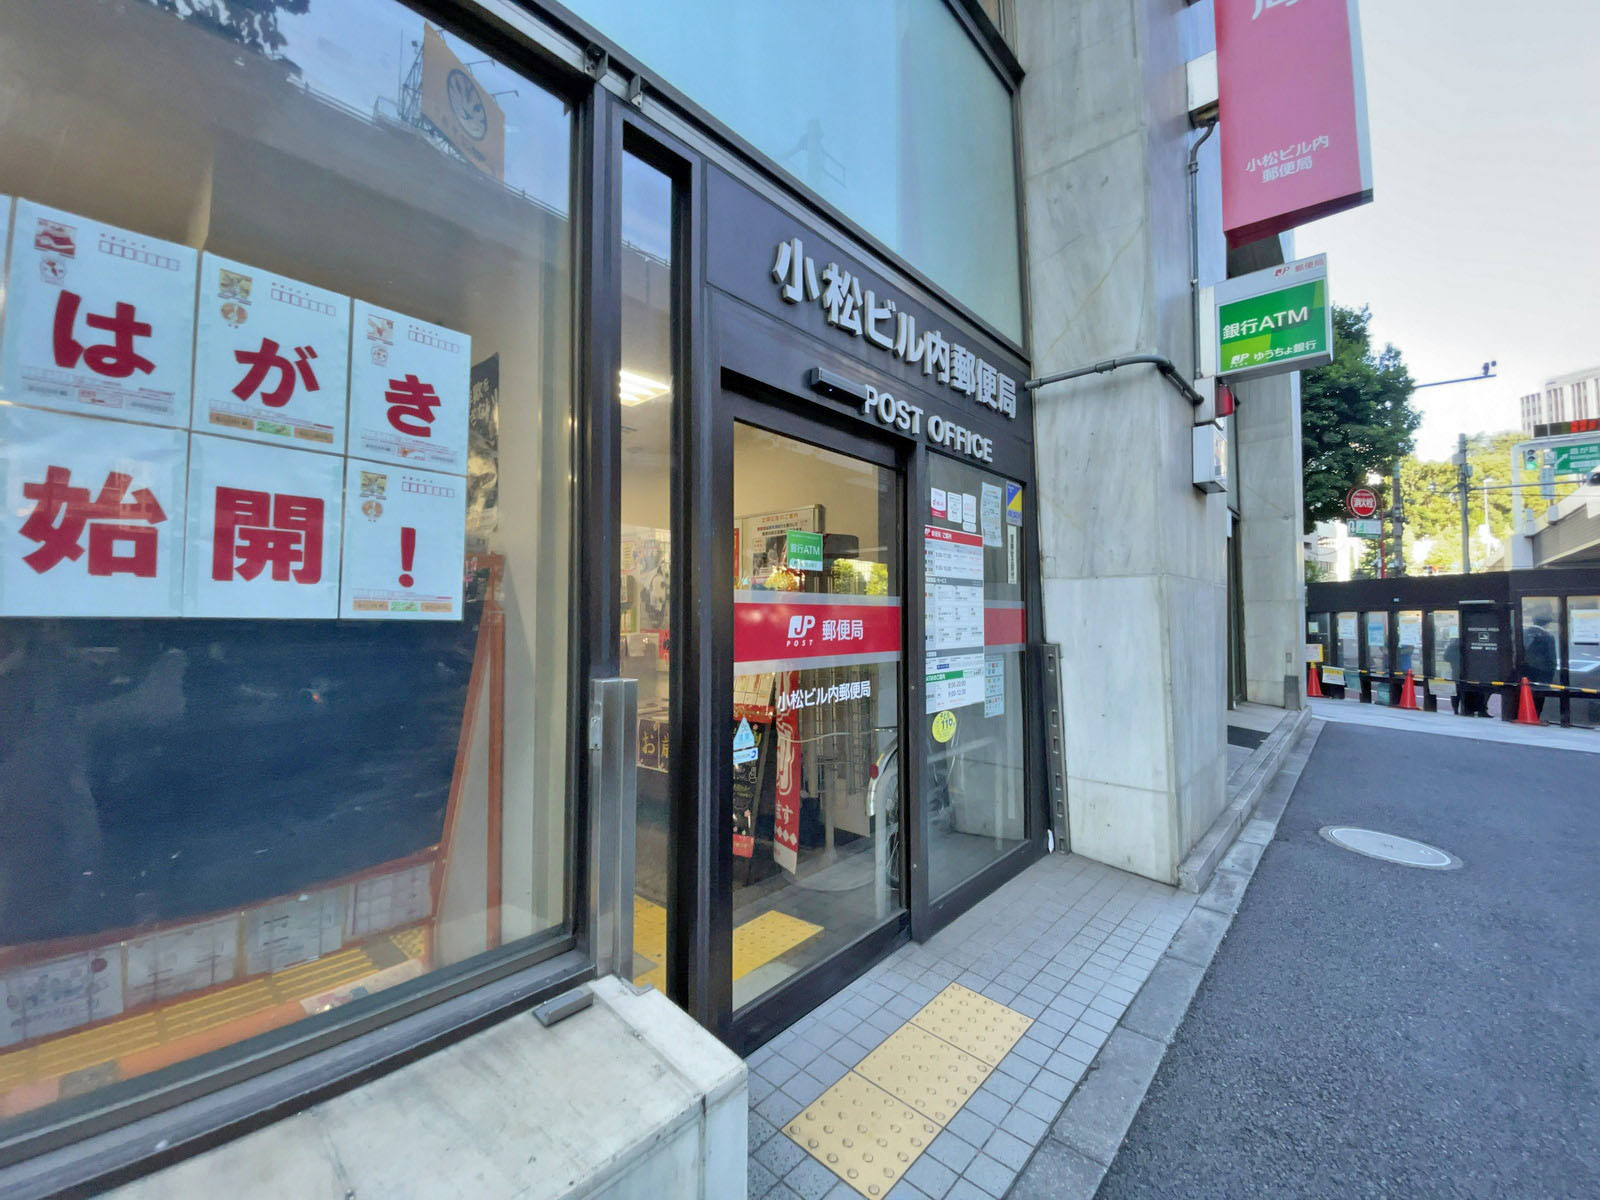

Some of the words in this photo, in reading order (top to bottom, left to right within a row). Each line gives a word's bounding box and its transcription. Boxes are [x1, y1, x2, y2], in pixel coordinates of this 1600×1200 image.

[1246, 135, 1329, 172] 小松ビル内
[1262, 156, 1313, 183] 郵便局
[772, 237, 1016, 419] 小松ビル内郵便局
[1222, 306, 1308, 340] 銀行ATM
[1253, 339, 1317, 362] ゆうちょ銀行
[863, 384, 924, 434] POST
[927, 415, 993, 463] OFFICE
[786, 639, 814, 647] POST
[822, 619, 864, 641] 郵便局
[777, 680, 871, 712] 小松ビル内郵便局
